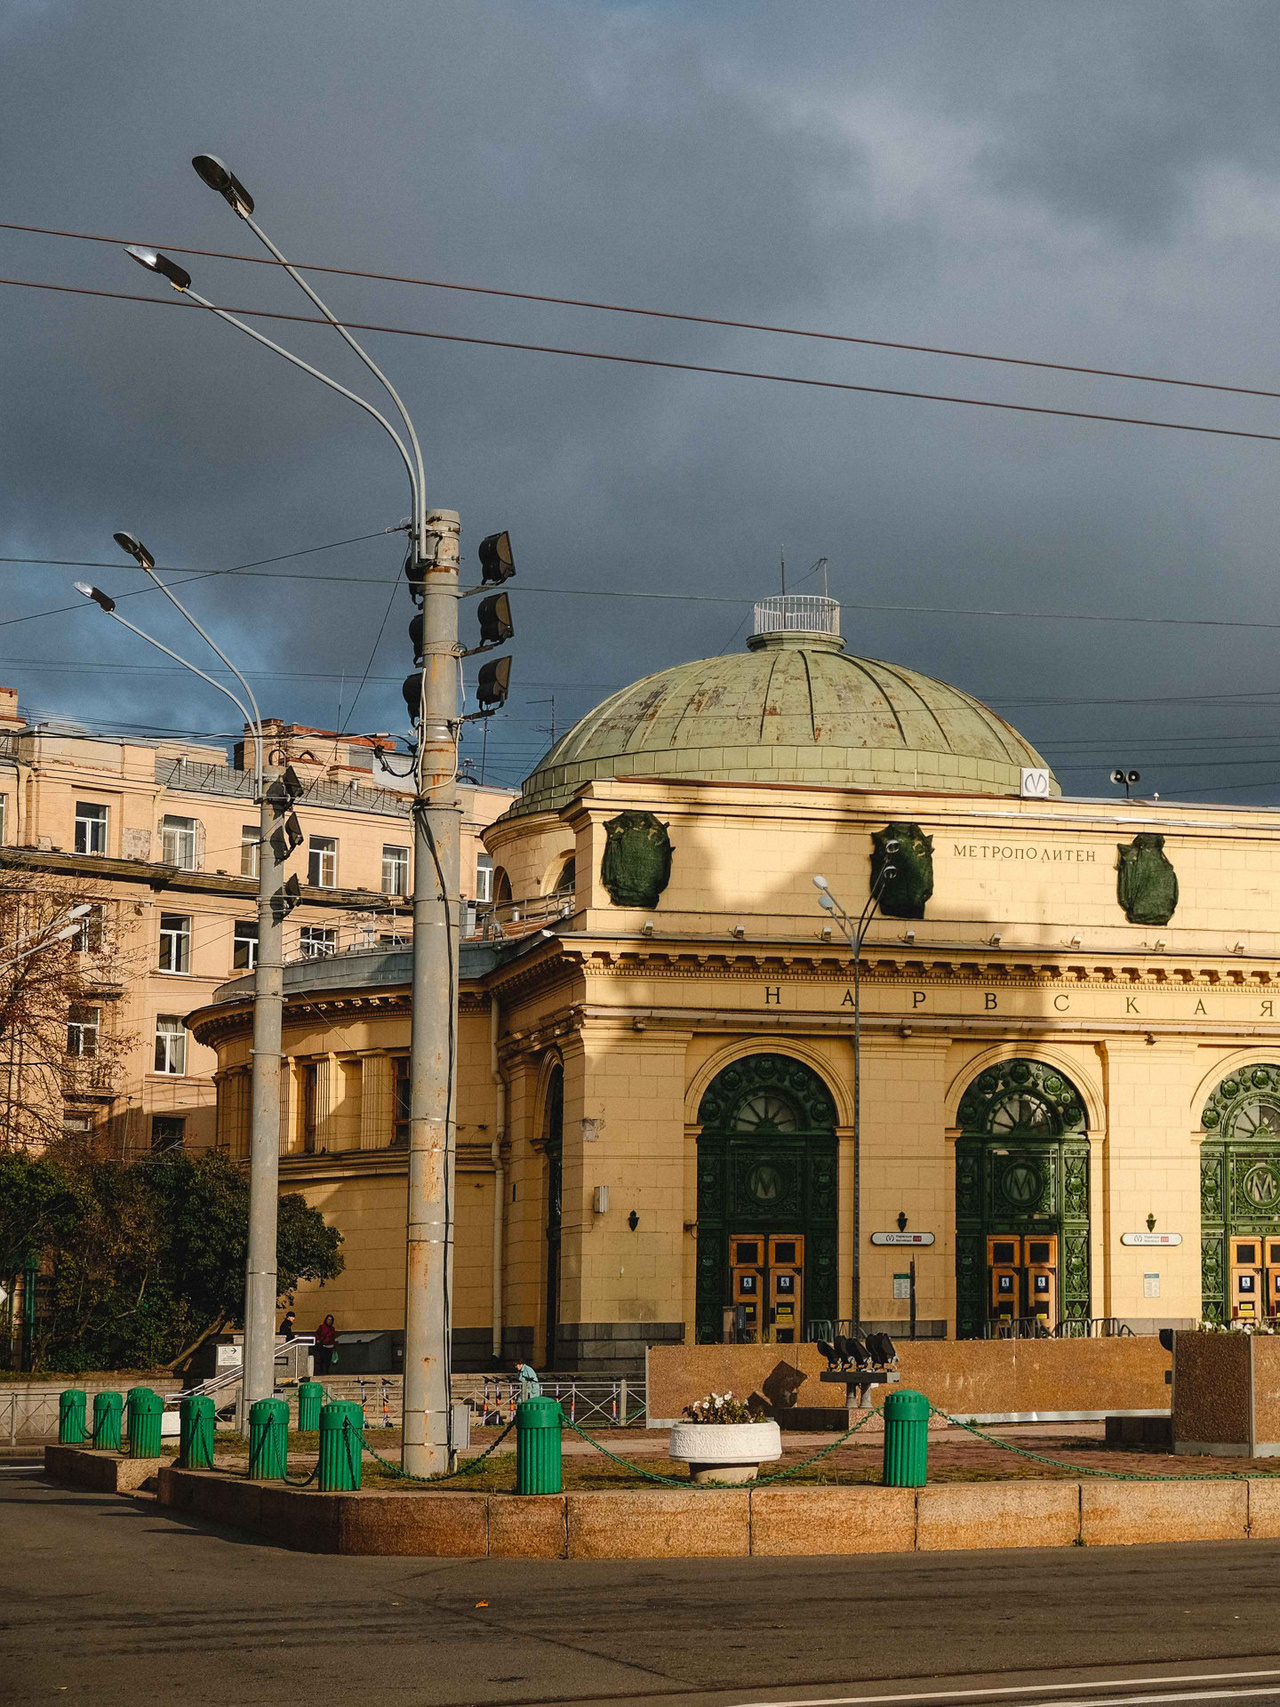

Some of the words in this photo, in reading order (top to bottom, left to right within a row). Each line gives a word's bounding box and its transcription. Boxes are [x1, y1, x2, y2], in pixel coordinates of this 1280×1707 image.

[954, 844, 1096, 862] МЕТРОПОЛИТЕН
[764, 986, 1274, 1017] НАРВСКАЯ
[1251, 1225, 1278, 1234] ВХОД
